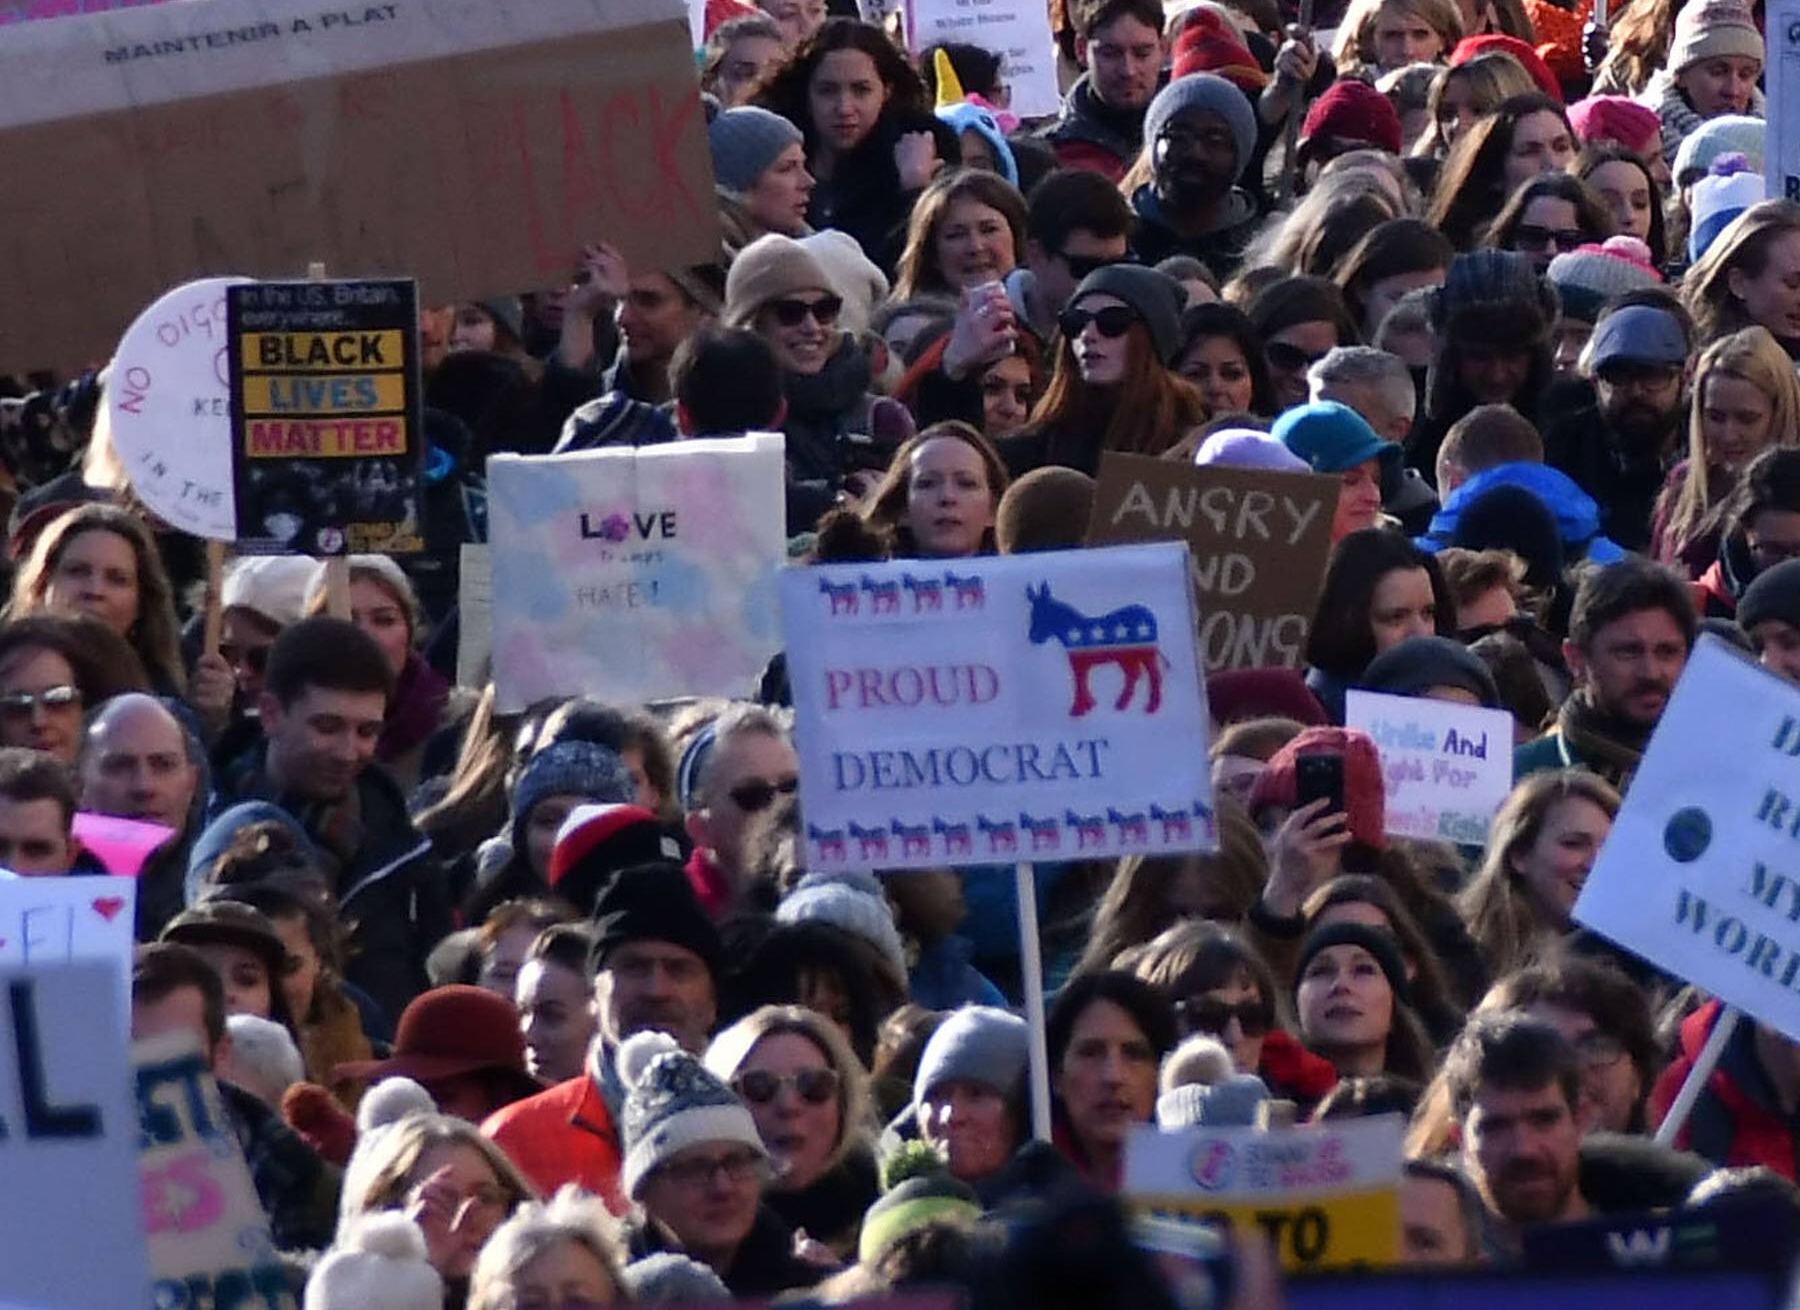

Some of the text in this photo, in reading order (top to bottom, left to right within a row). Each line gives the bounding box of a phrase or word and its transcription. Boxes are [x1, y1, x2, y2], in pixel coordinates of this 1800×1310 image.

[104, 2, 400, 65] MAINTENIR A PLAT
[260, 335, 384, 365] BLACK
[270, 377, 378, 411] LIVES
[251, 421, 398, 452] MATTER
[1112, 482, 1323, 546] ANGRY
[824, 663, 1001, 710] PROUD
[1443, 728, 1487, 760] And
[832, 738, 1110, 791] DEMOCRAT
[1433, 759, 1477, 789] For
